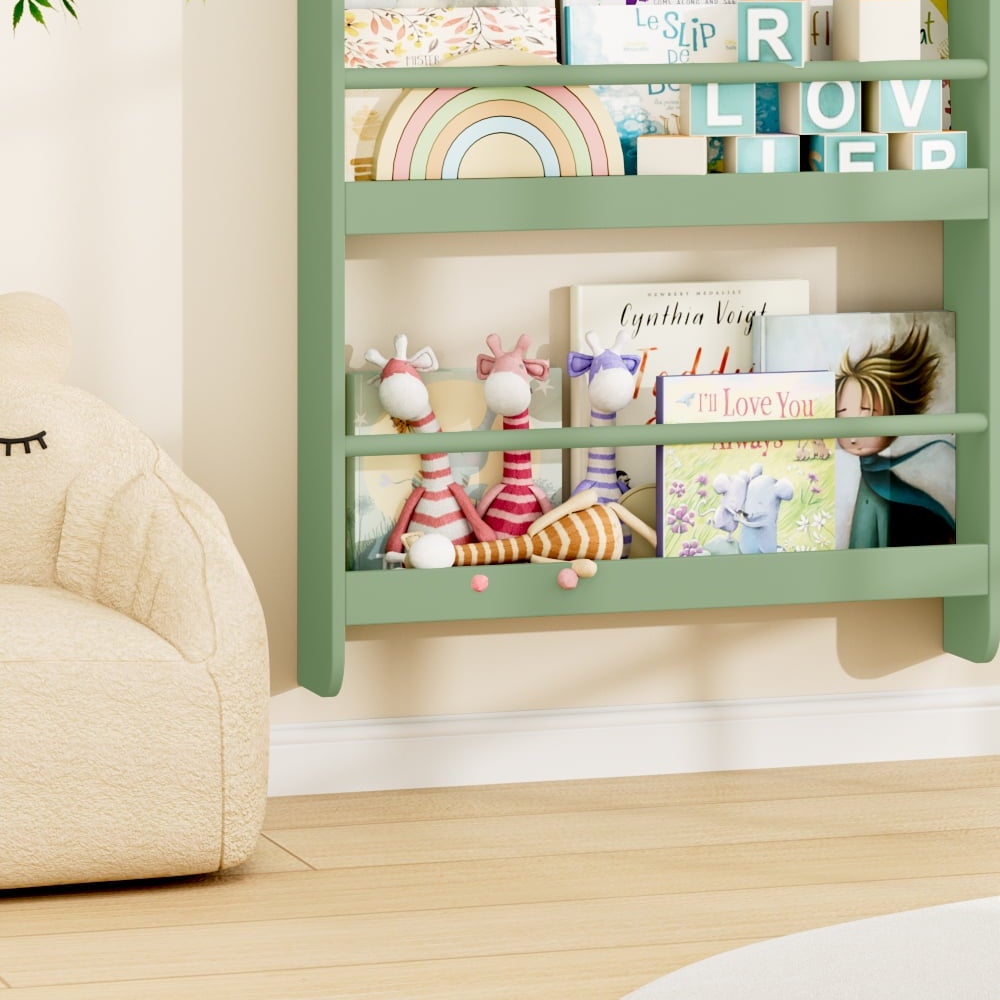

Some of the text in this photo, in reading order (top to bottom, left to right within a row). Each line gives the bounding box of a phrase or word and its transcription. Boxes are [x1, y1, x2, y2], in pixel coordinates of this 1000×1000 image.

[636, 8, 659, 30] Le
[746, 7, 793, 61] R
[707, 80, 931, 130] L O V
[620, 301, 704, 338] Cynthia
[723, 388, 772, 417] Love
[775, 391, 815, 419] You
